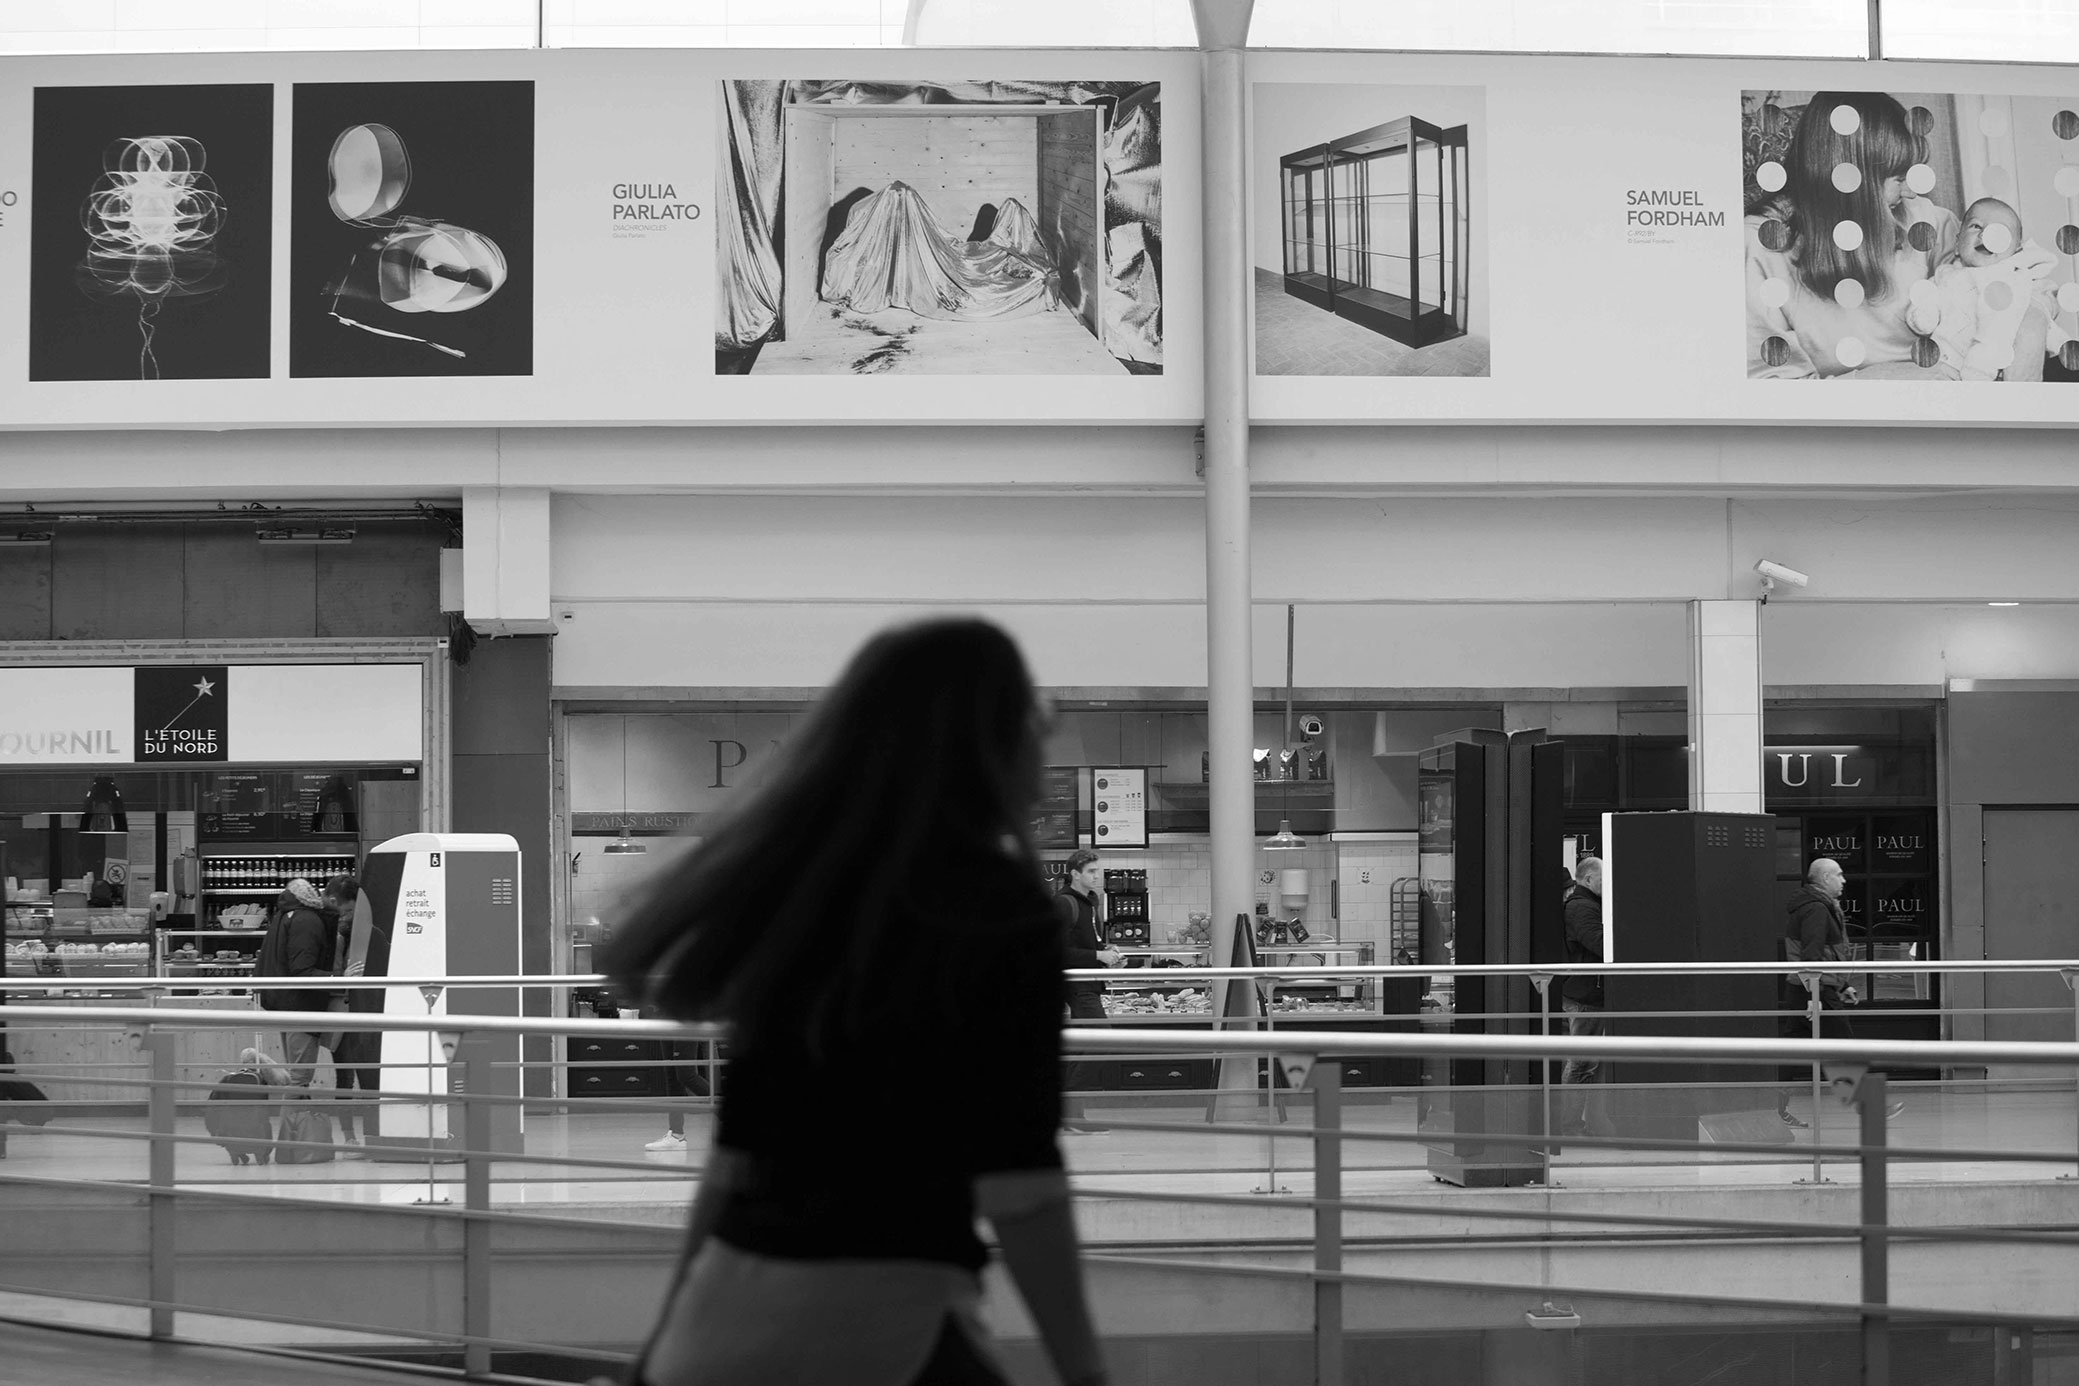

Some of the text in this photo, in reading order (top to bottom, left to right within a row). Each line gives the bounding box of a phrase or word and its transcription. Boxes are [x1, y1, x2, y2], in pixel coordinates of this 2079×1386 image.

[613, 183, 677, 199] GIULIA
[1627, 190, 1704, 206] SAMUEL
[0, 191, 17, 206] O
[613, 204, 701, 220] PARLATO
[1627, 210, 1725, 227] FORDHAM
[145, 742, 218, 754] DU NORD
[1777, 753, 1862, 787] UL
[592, 815, 638, 828] PAINS
[1813, 836, 1862, 850] PAUL
[1877, 835, 1924, 849] PAUL
[406, 889, 427, 897] achat
[406, 899, 430, 907] retrait
[1839, 899, 1862, 913] UL
[1878, 898, 1925, 912] PAUL
[406, 909, 437, 919] échange
